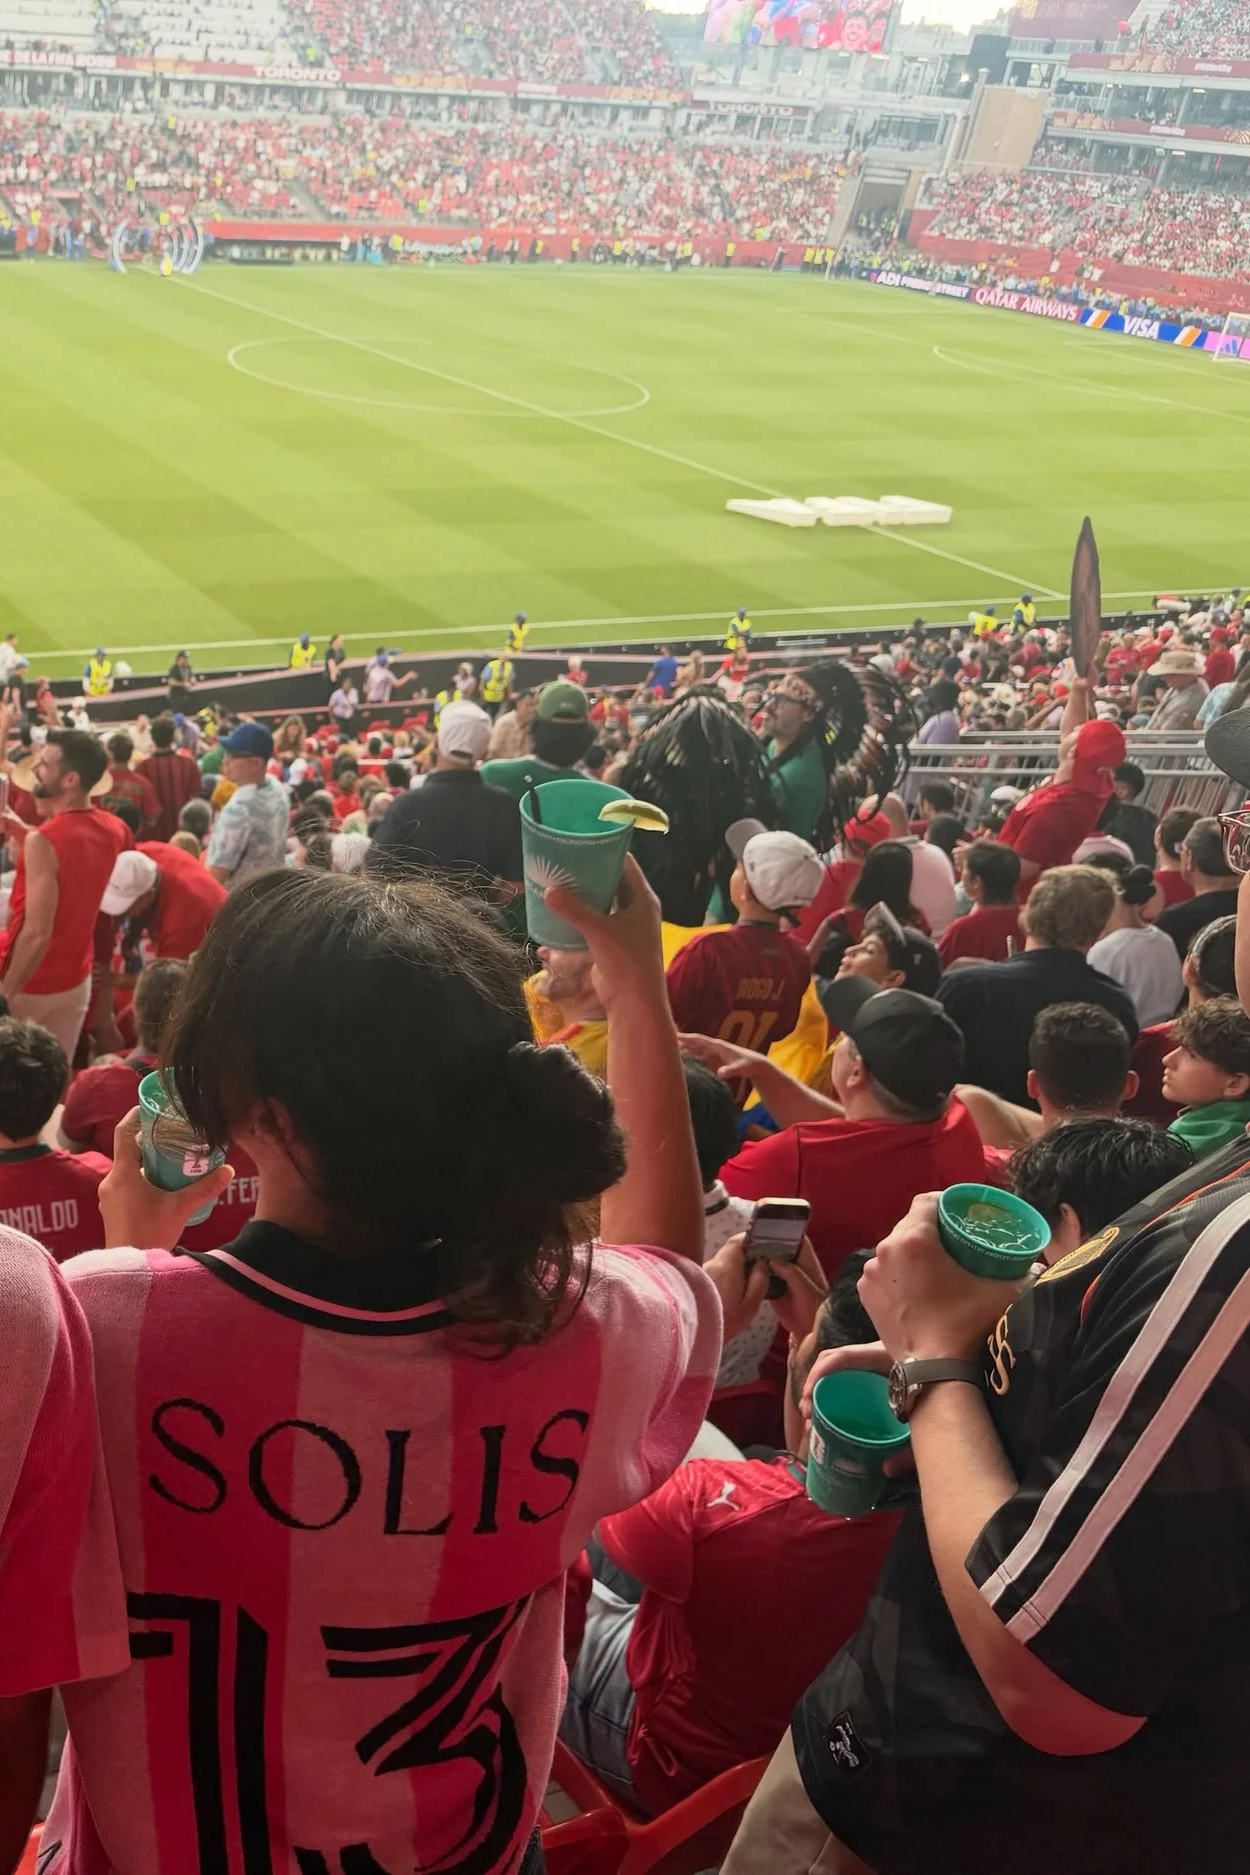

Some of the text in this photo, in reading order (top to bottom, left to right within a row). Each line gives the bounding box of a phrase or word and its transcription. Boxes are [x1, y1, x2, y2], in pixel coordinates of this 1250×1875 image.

[253, 64, 342, 82] TORONTO
[708, 100, 794, 115] TORONTO
[975, 287, 1079, 321] QATAR AIRWAYS
[1123, 314, 1160, 340] VISA
[150, 1397, 589, 1536] SOLIS
[126, 1591, 530, 1875] 13
